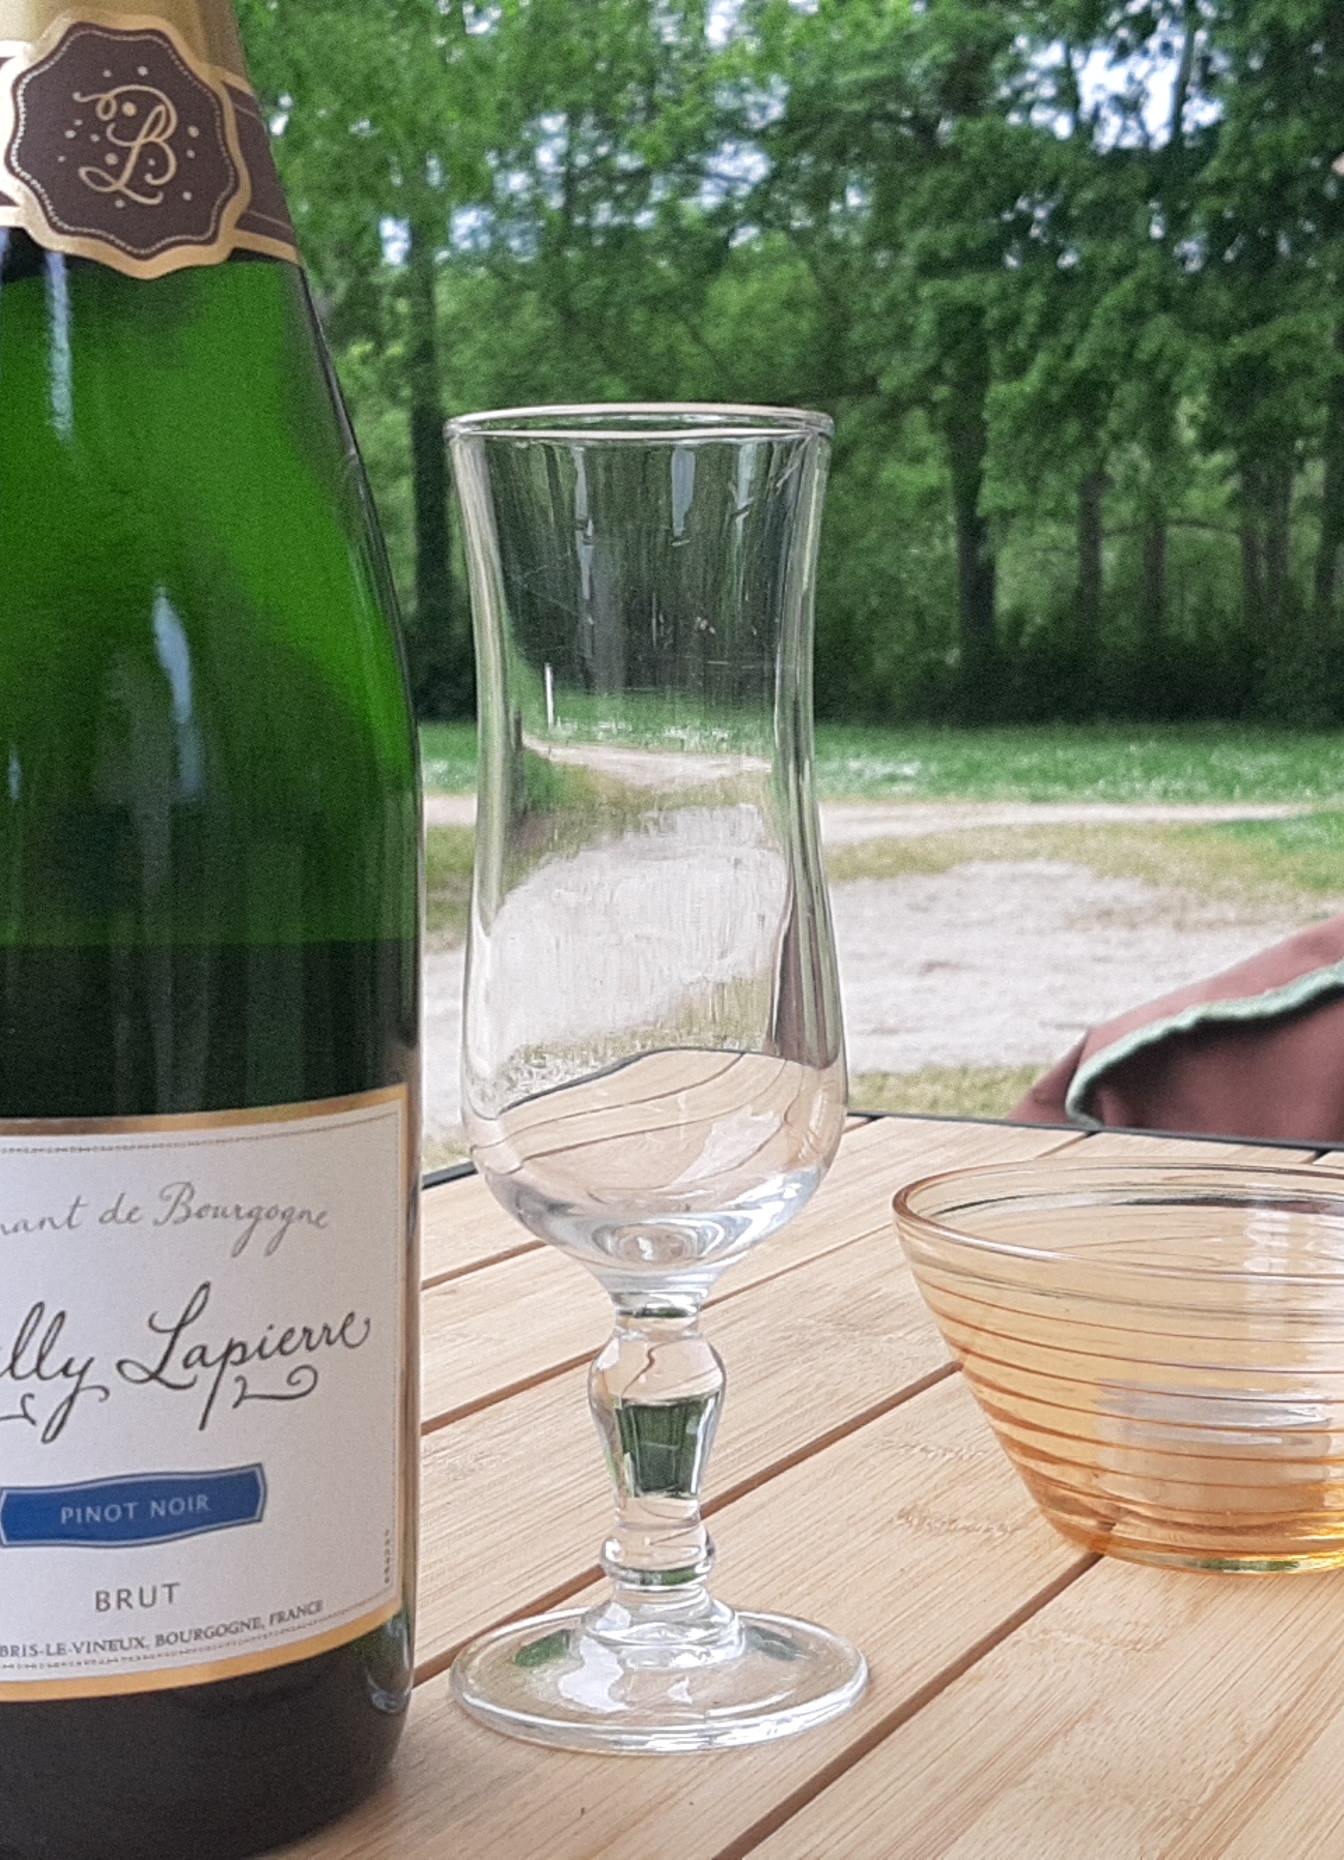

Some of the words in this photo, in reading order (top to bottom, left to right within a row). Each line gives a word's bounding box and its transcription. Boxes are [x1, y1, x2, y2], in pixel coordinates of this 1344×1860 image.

[98, 1191, 144, 1226] de
[152, 1180, 330, 1258] Bourgogne
[116, 1281, 373, 1431] Lapierre
[60, 1501, 139, 1525] PINOT
[150, 1493, 211, 1519] NOIR
[94, 1582, 181, 1613] BRUT
[155, 1617, 266, 1648] BOURGOGNE,
[269, 1600, 325, 1627] FRANCE
